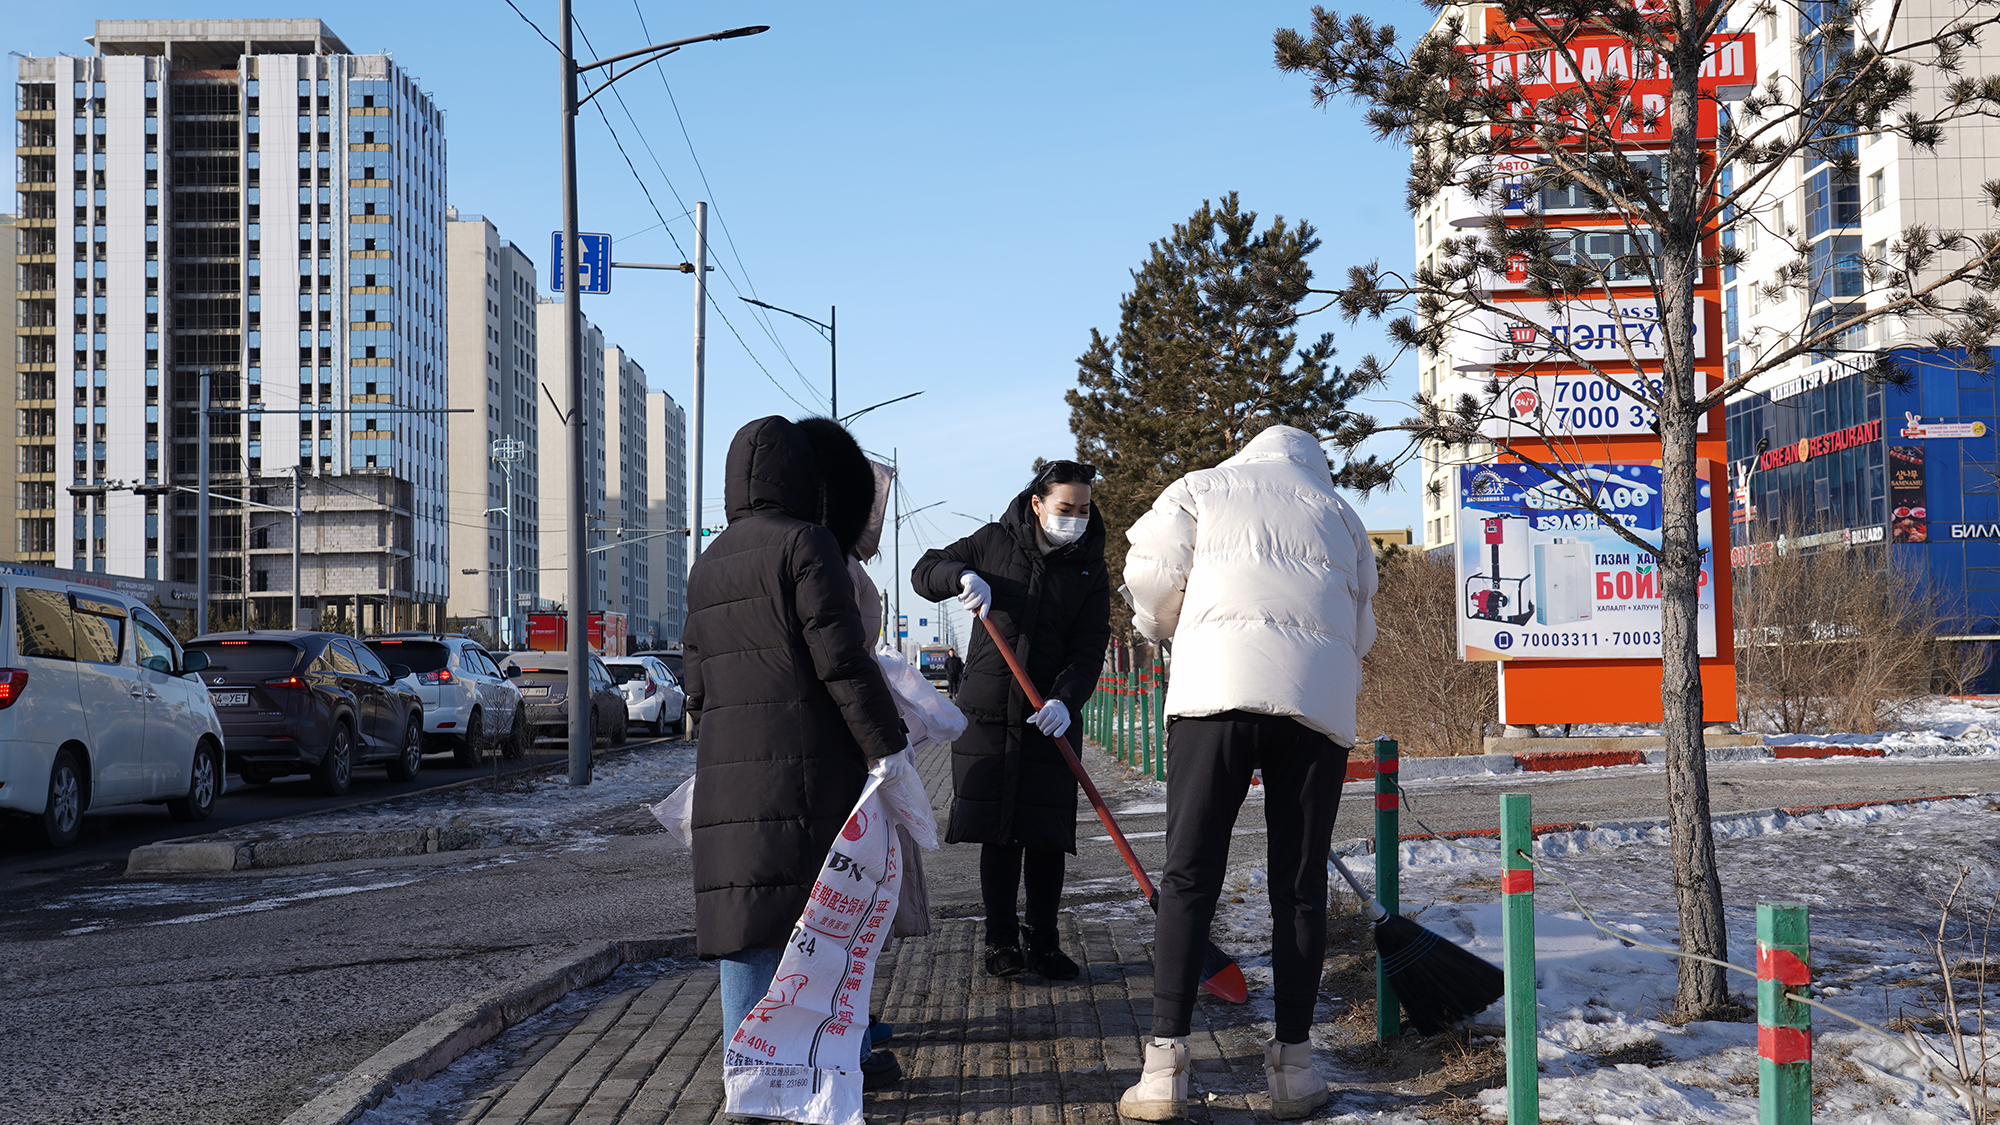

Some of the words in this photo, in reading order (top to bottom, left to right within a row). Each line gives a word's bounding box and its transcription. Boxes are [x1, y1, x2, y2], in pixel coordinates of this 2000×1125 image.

[1620, 94, 1673, 134] LP
[1497, 160, 1530, 172] АВТО
[1803, 371, 1821, 392] ГЭР
[1556, 380, 1621, 402] 7000
[1515, 398, 1535, 407] 24/7
[1555, 405, 1620, 429] 7000
[1760, 443, 1800, 472] KOREAN
[1809, 419, 1881, 459] RESTAURANT
[1536, 513, 1600, 531] БЭЛЭН
[1595, 553, 1630, 565] ГАЗАН
[1595, 569, 1709, 600] БОЙР
[1596, 604, 1627, 612] ХАЛААЛТ
[1521, 632, 1599, 647] 70003311
[1612, 630, 1661, 646] 70003
[229, 693, 247, 703] УЕТ
[747, 1036, 777, 1057] 40kg
[786, 1078, 809, 1088] 231600
